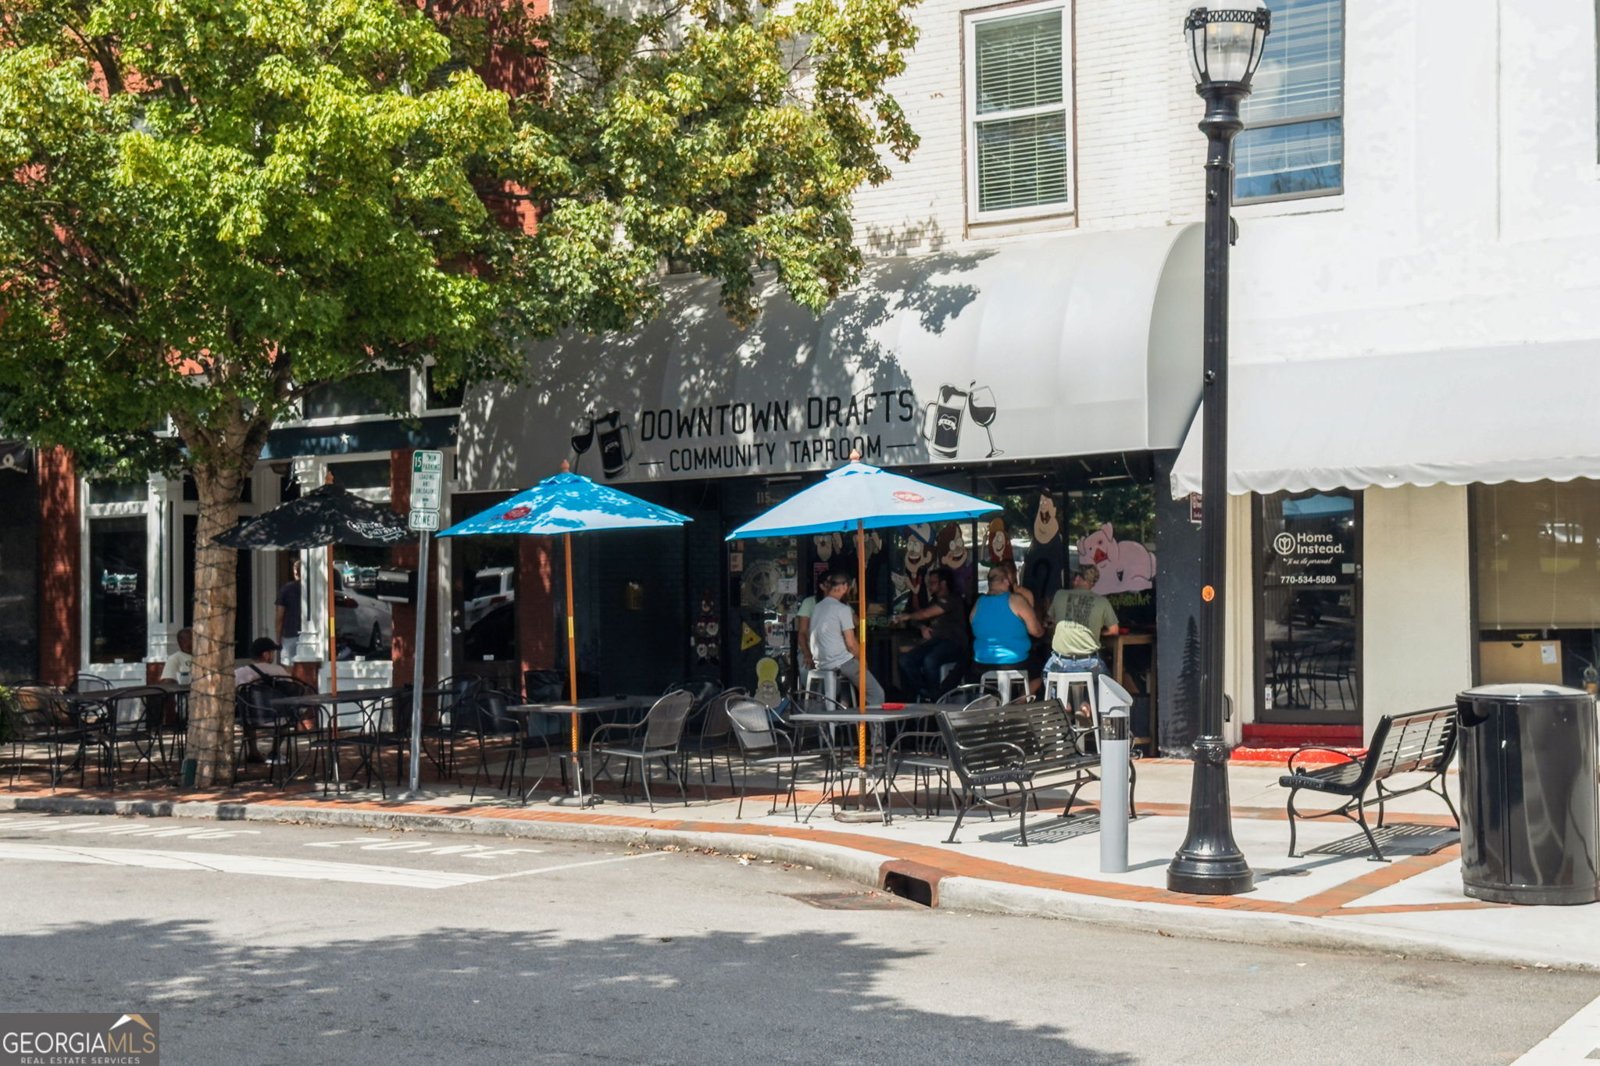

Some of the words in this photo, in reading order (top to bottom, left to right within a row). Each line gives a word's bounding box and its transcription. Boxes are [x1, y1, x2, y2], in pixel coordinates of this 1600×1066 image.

[640, 400, 790, 442] DOWNTOWN
[806, 389, 915, 430] DRAFTS
[669, 441, 777, 473] COMMUNITY
[789, 434, 882, 465] TAPROOM
[414, 456, 422, 468] 15
[413, 514, 430, 526] ZONE
[1297, 532, 1333, 543] Home
[1280, 575, 1337, 584] 770-534-5880
[0, 817, 262, 840] OADING
[302, 836, 546, 860] ZONE
